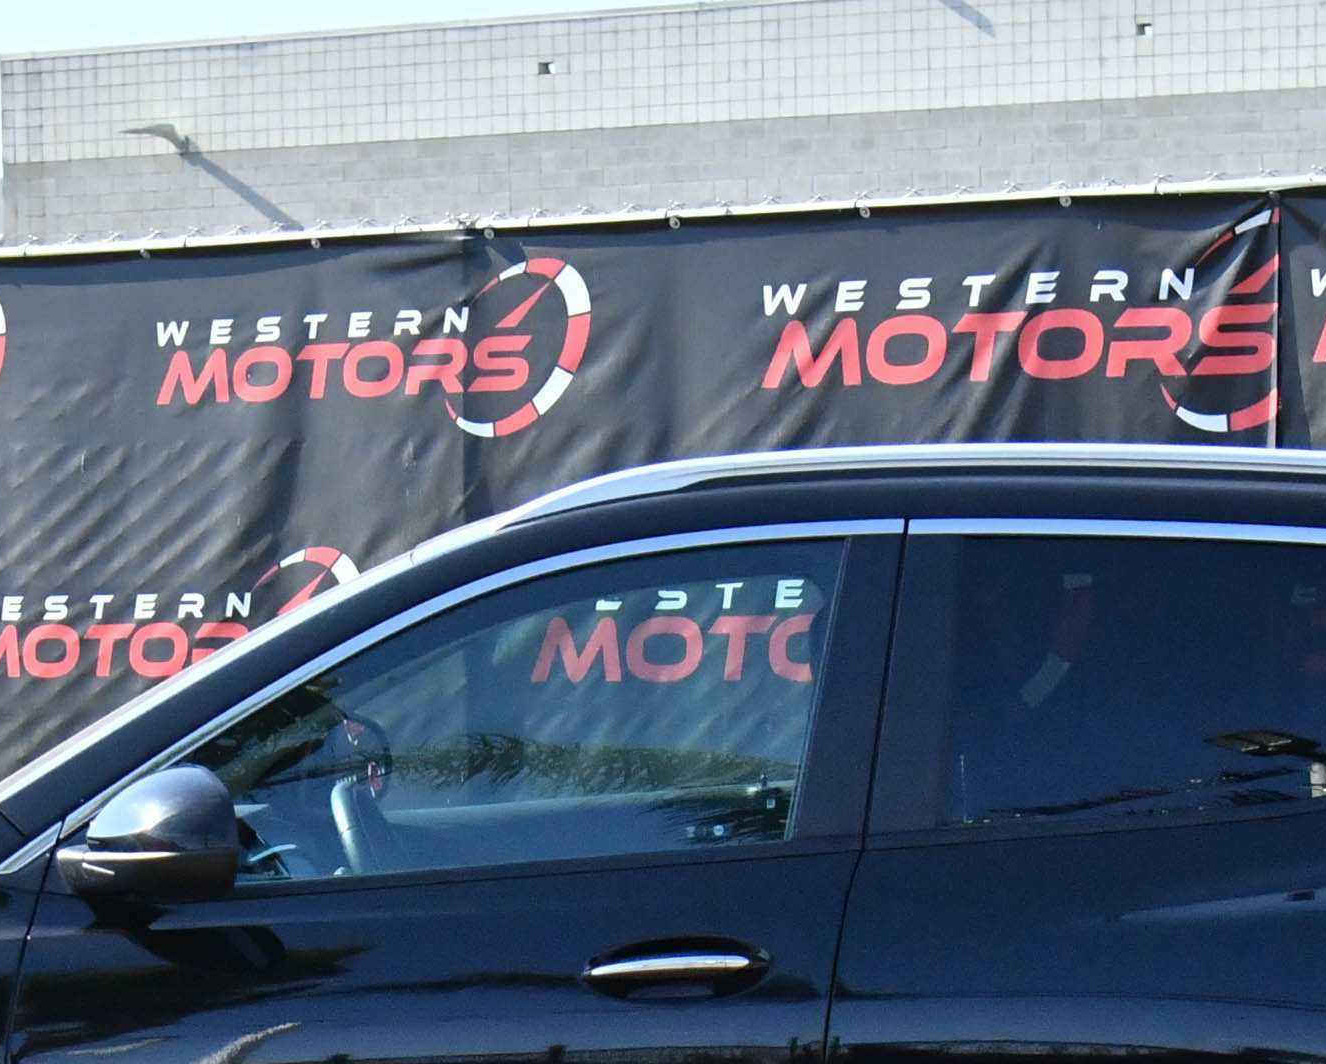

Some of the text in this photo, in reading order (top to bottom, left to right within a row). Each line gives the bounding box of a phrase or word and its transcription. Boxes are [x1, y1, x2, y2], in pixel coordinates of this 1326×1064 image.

[762, 268, 1195, 316] WESTERN
[156, 307, 469, 347] WESTERN
[761, 302, 1278, 389] MOTORS
[158, 335, 532, 405] MOTORS
[535, 616, 809, 681] MOTO
